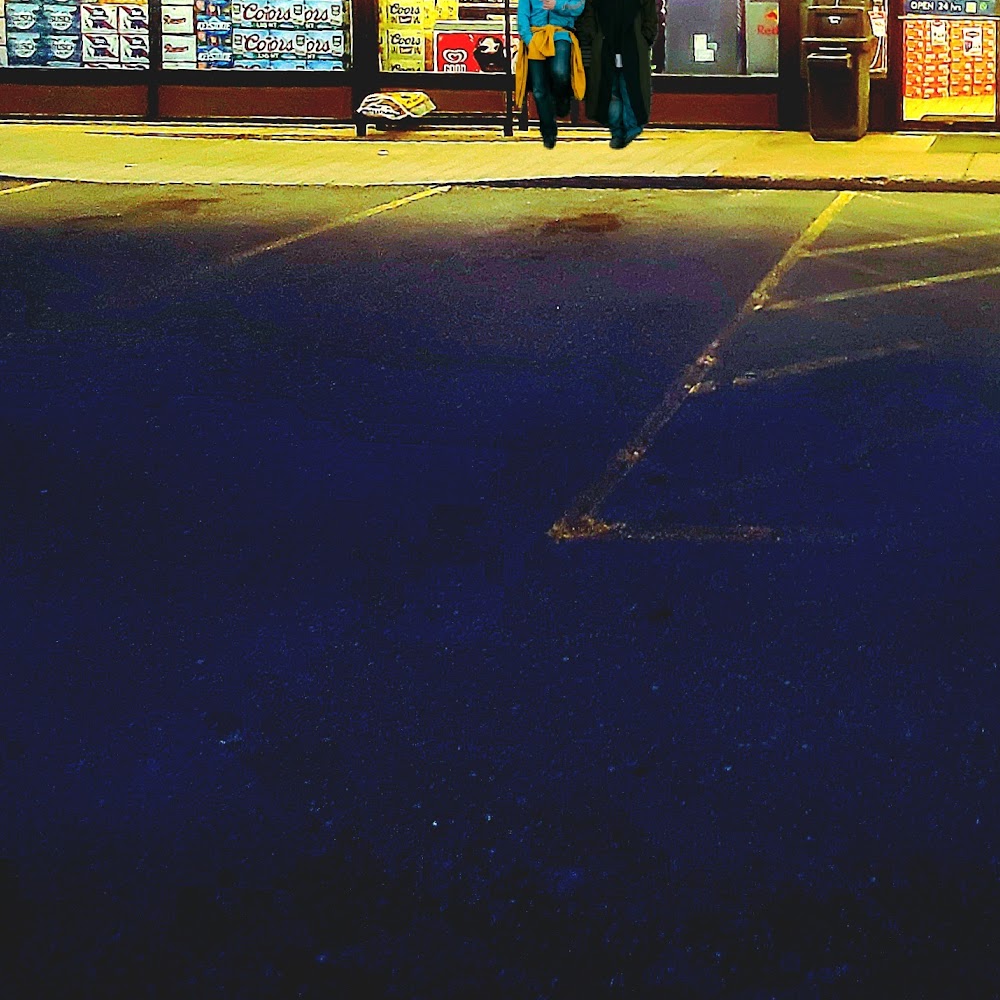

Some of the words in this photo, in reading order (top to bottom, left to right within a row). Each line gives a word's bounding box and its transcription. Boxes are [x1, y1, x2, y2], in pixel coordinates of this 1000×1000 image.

[242, 2, 291, 21] Coors
[389, 3, 421, 16] Coors
[910, 0, 934, 10] OPEN
[937, 1, 948, 11] 24
[244, 34, 295, 53] Coors
[390, 34, 421, 47] Coors
